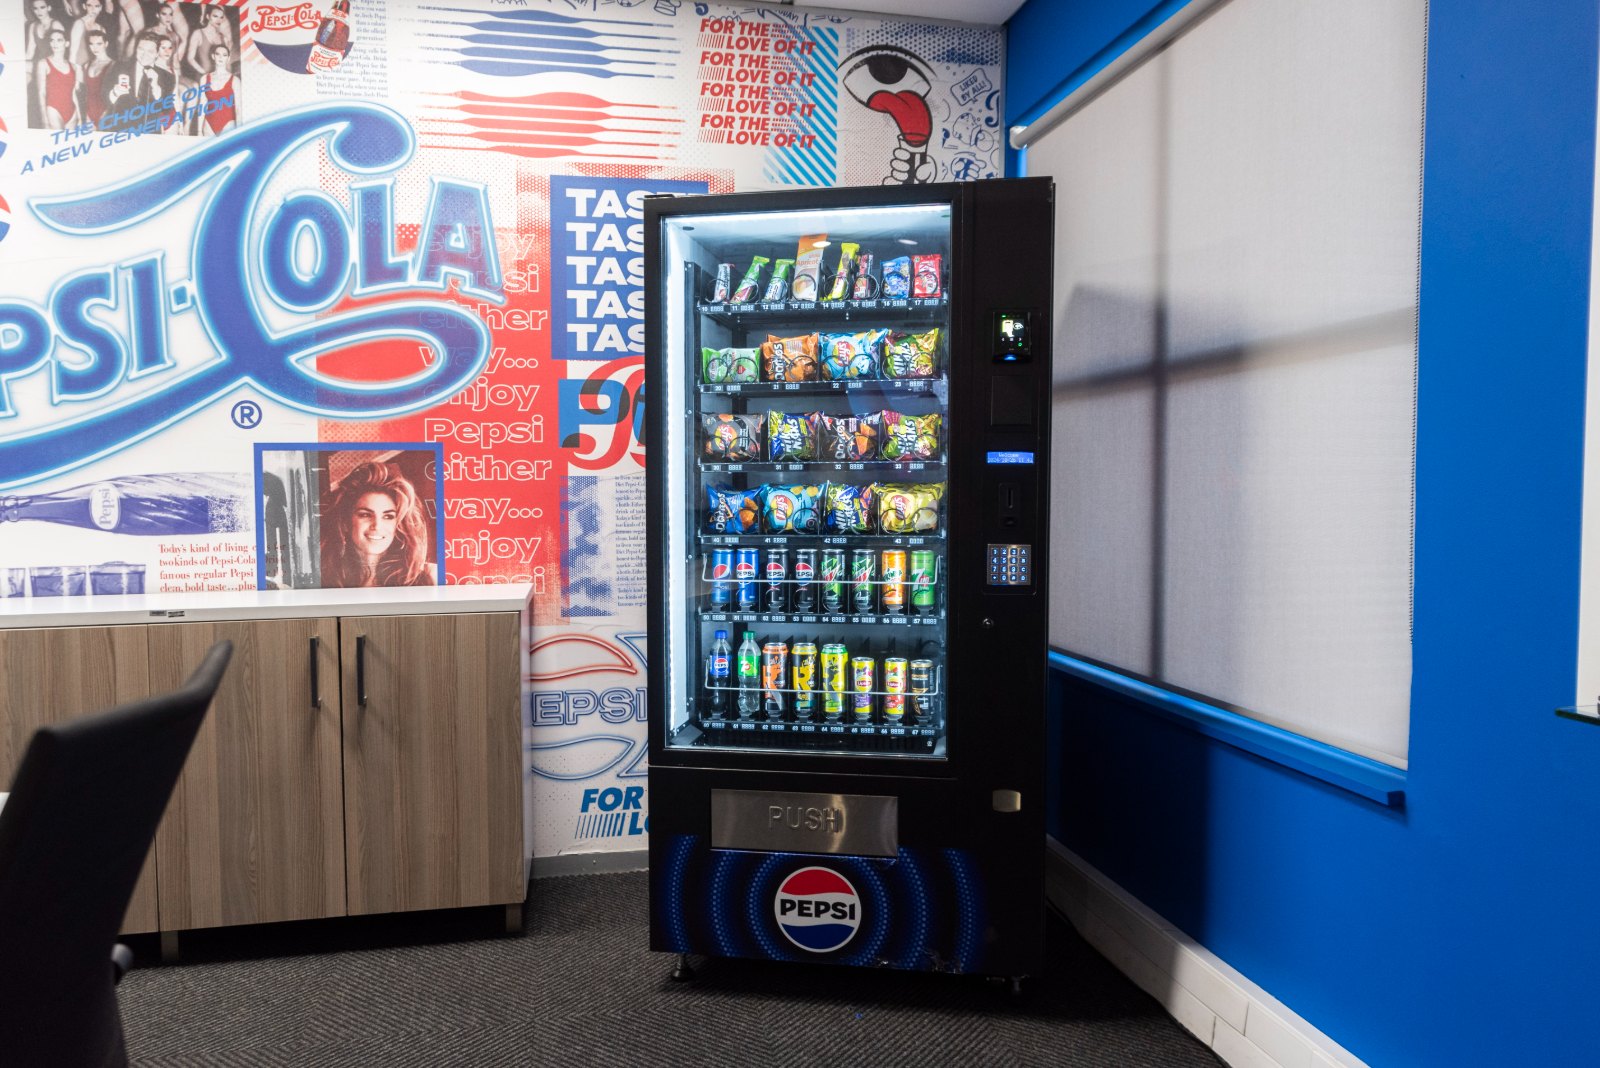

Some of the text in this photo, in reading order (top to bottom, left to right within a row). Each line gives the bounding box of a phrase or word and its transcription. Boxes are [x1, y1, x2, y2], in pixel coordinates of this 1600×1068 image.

[700, 18, 771, 37] FOR THE
[726, 35, 816, 55] LOVE OF IT
[700, 51, 771, 69] FOR THE
[726, 67, 816, 87] LOVE OF IT
[960, 75, 978, 92] LIKED
[700, 82, 771, 100] FOR THE
[961, 91, 972, 102] BY
[51, 82, 213, 145] THE CHOICE OF
[726, 98, 816, 117] LOVE OF IT
[700, 113, 771, 132] FOR THE
[20, 95, 235, 175] A NEW GENERATION
[726, 130, 816, 149] LOVE OF IT
[424, 415, 544, 449] Pepsi
[424, 452, 552, 481] either
[99, 488, 113, 526] Pepsi
[424, 498, 543, 525] way...
[190, 543, 210, 553] kind
[212, 543, 223, 552] of
[224, 542, 249, 553] living
[194, 568, 228, 580] regular
[230, 568, 254, 580] Pepsi
[185, 582, 204, 592] bold
[581, 786, 644, 813] FOR
[768, 805, 842, 833] PUSH
[780, 898, 856, 920] PEPSI
